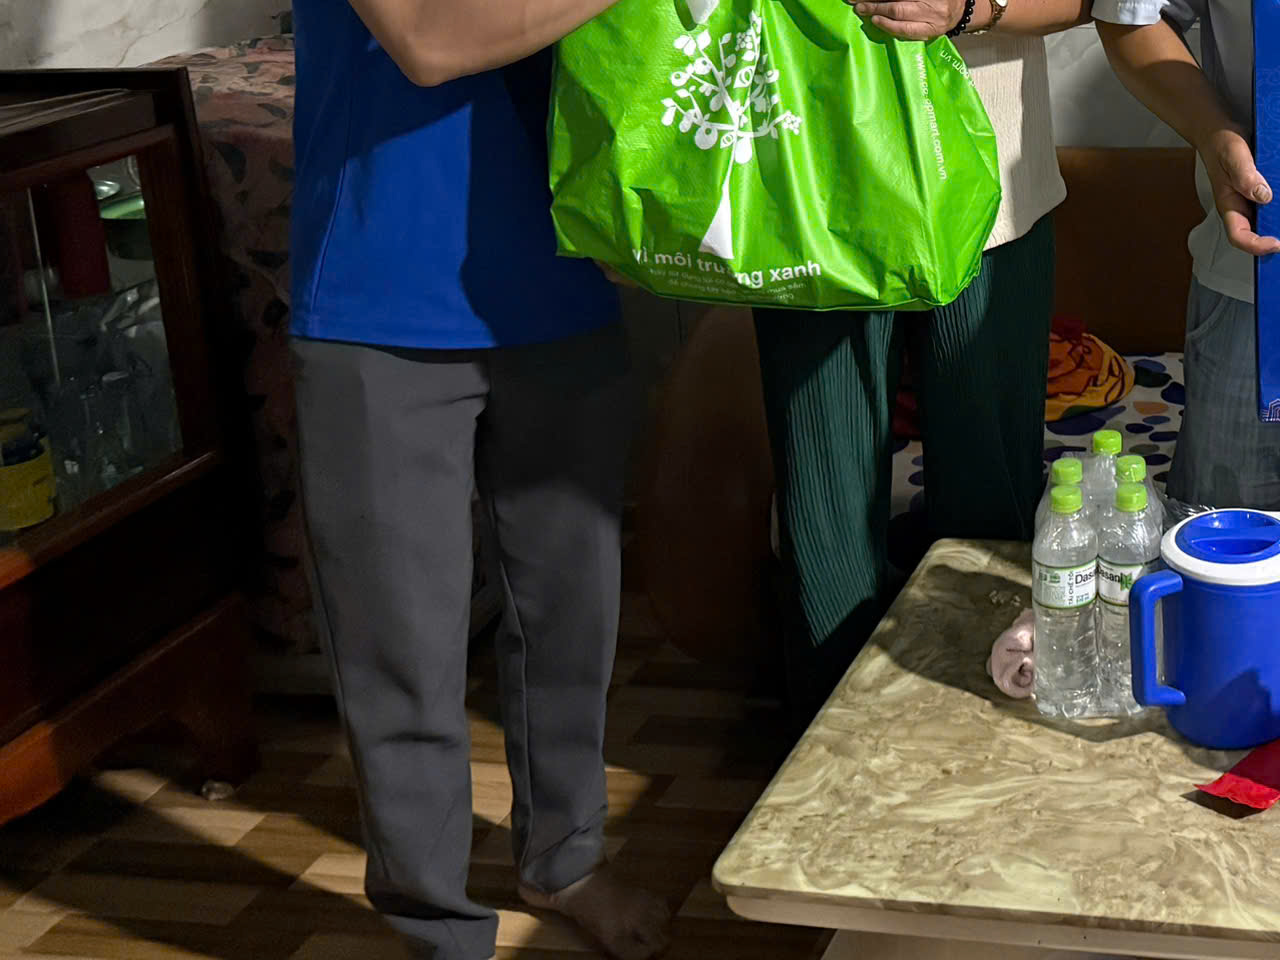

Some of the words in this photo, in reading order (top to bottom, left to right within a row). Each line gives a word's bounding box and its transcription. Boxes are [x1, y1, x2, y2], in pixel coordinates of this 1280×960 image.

[632, 246, 648, 265] Vì
[654, 252, 692, 268] môi
[769, 260, 822, 282] xanh
